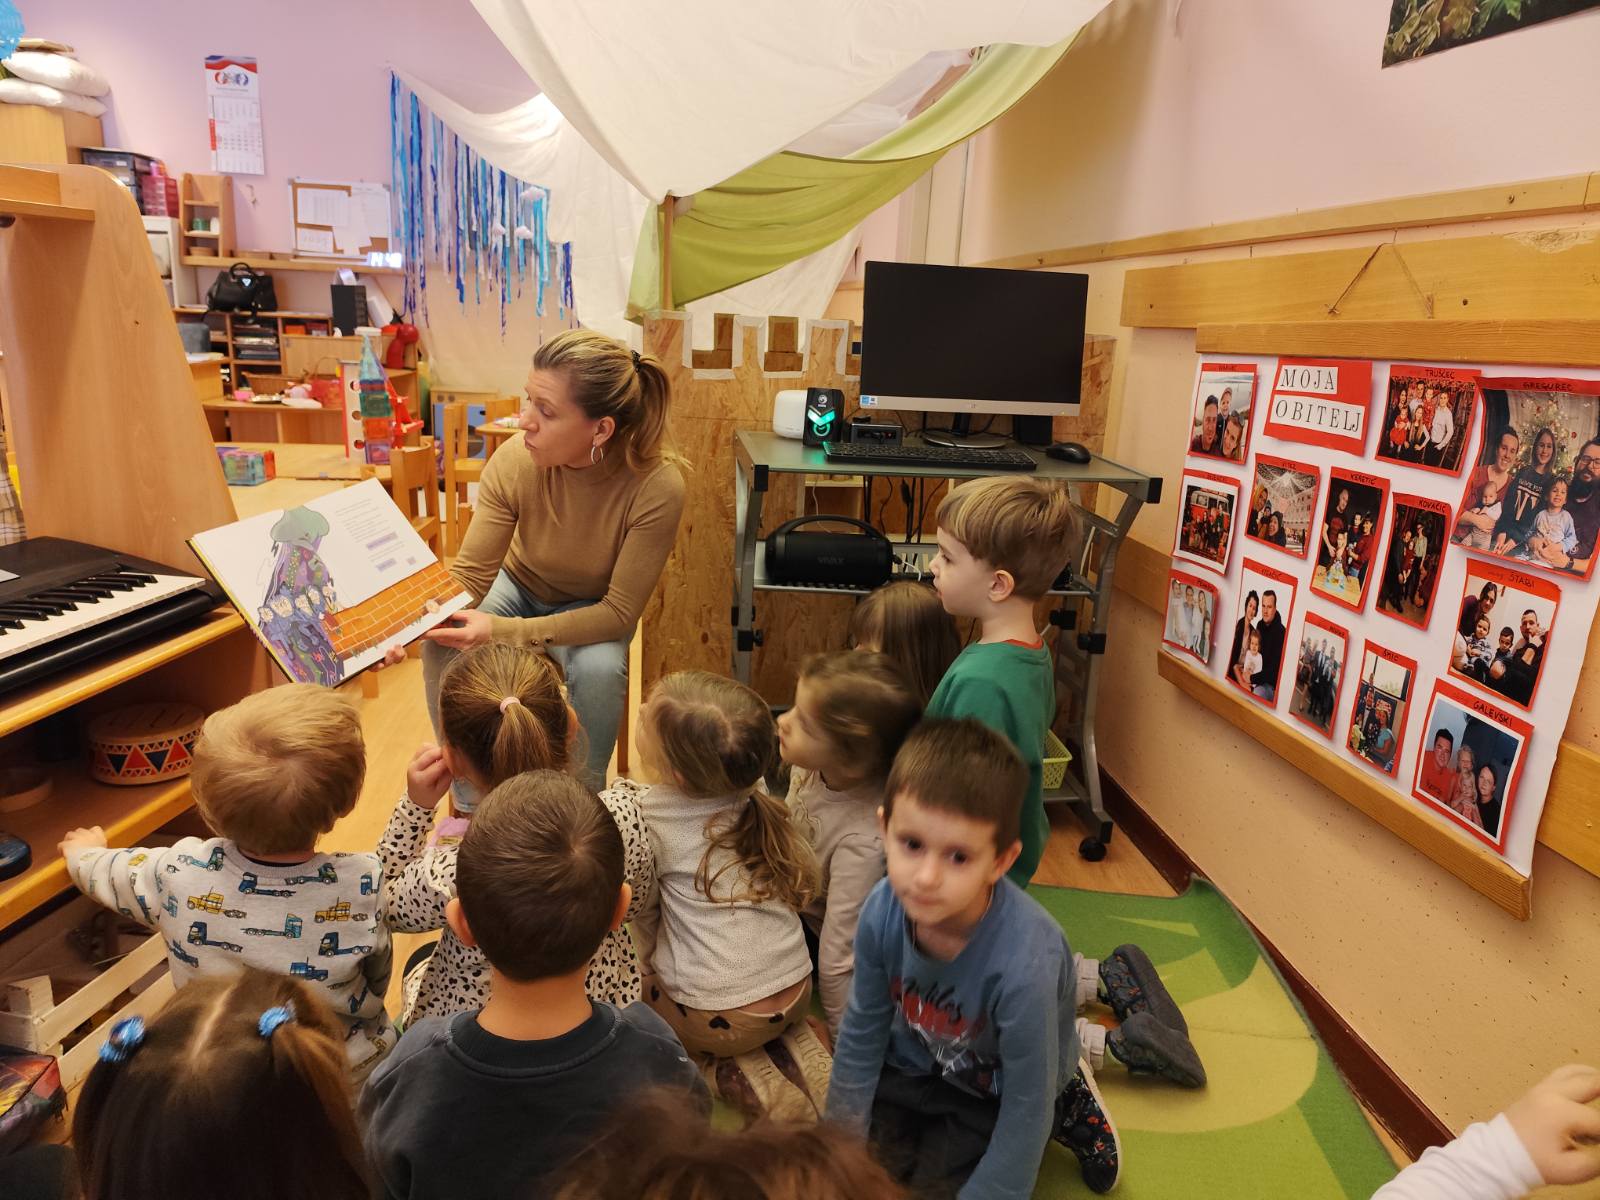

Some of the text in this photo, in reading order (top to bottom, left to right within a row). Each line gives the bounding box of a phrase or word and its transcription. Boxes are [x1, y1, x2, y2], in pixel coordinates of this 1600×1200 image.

[1280, 368, 1335, 390] MOJA
[1275, 399, 1361, 433] OBITELJ
[1472, 700, 1513, 728] GALEVSKI
